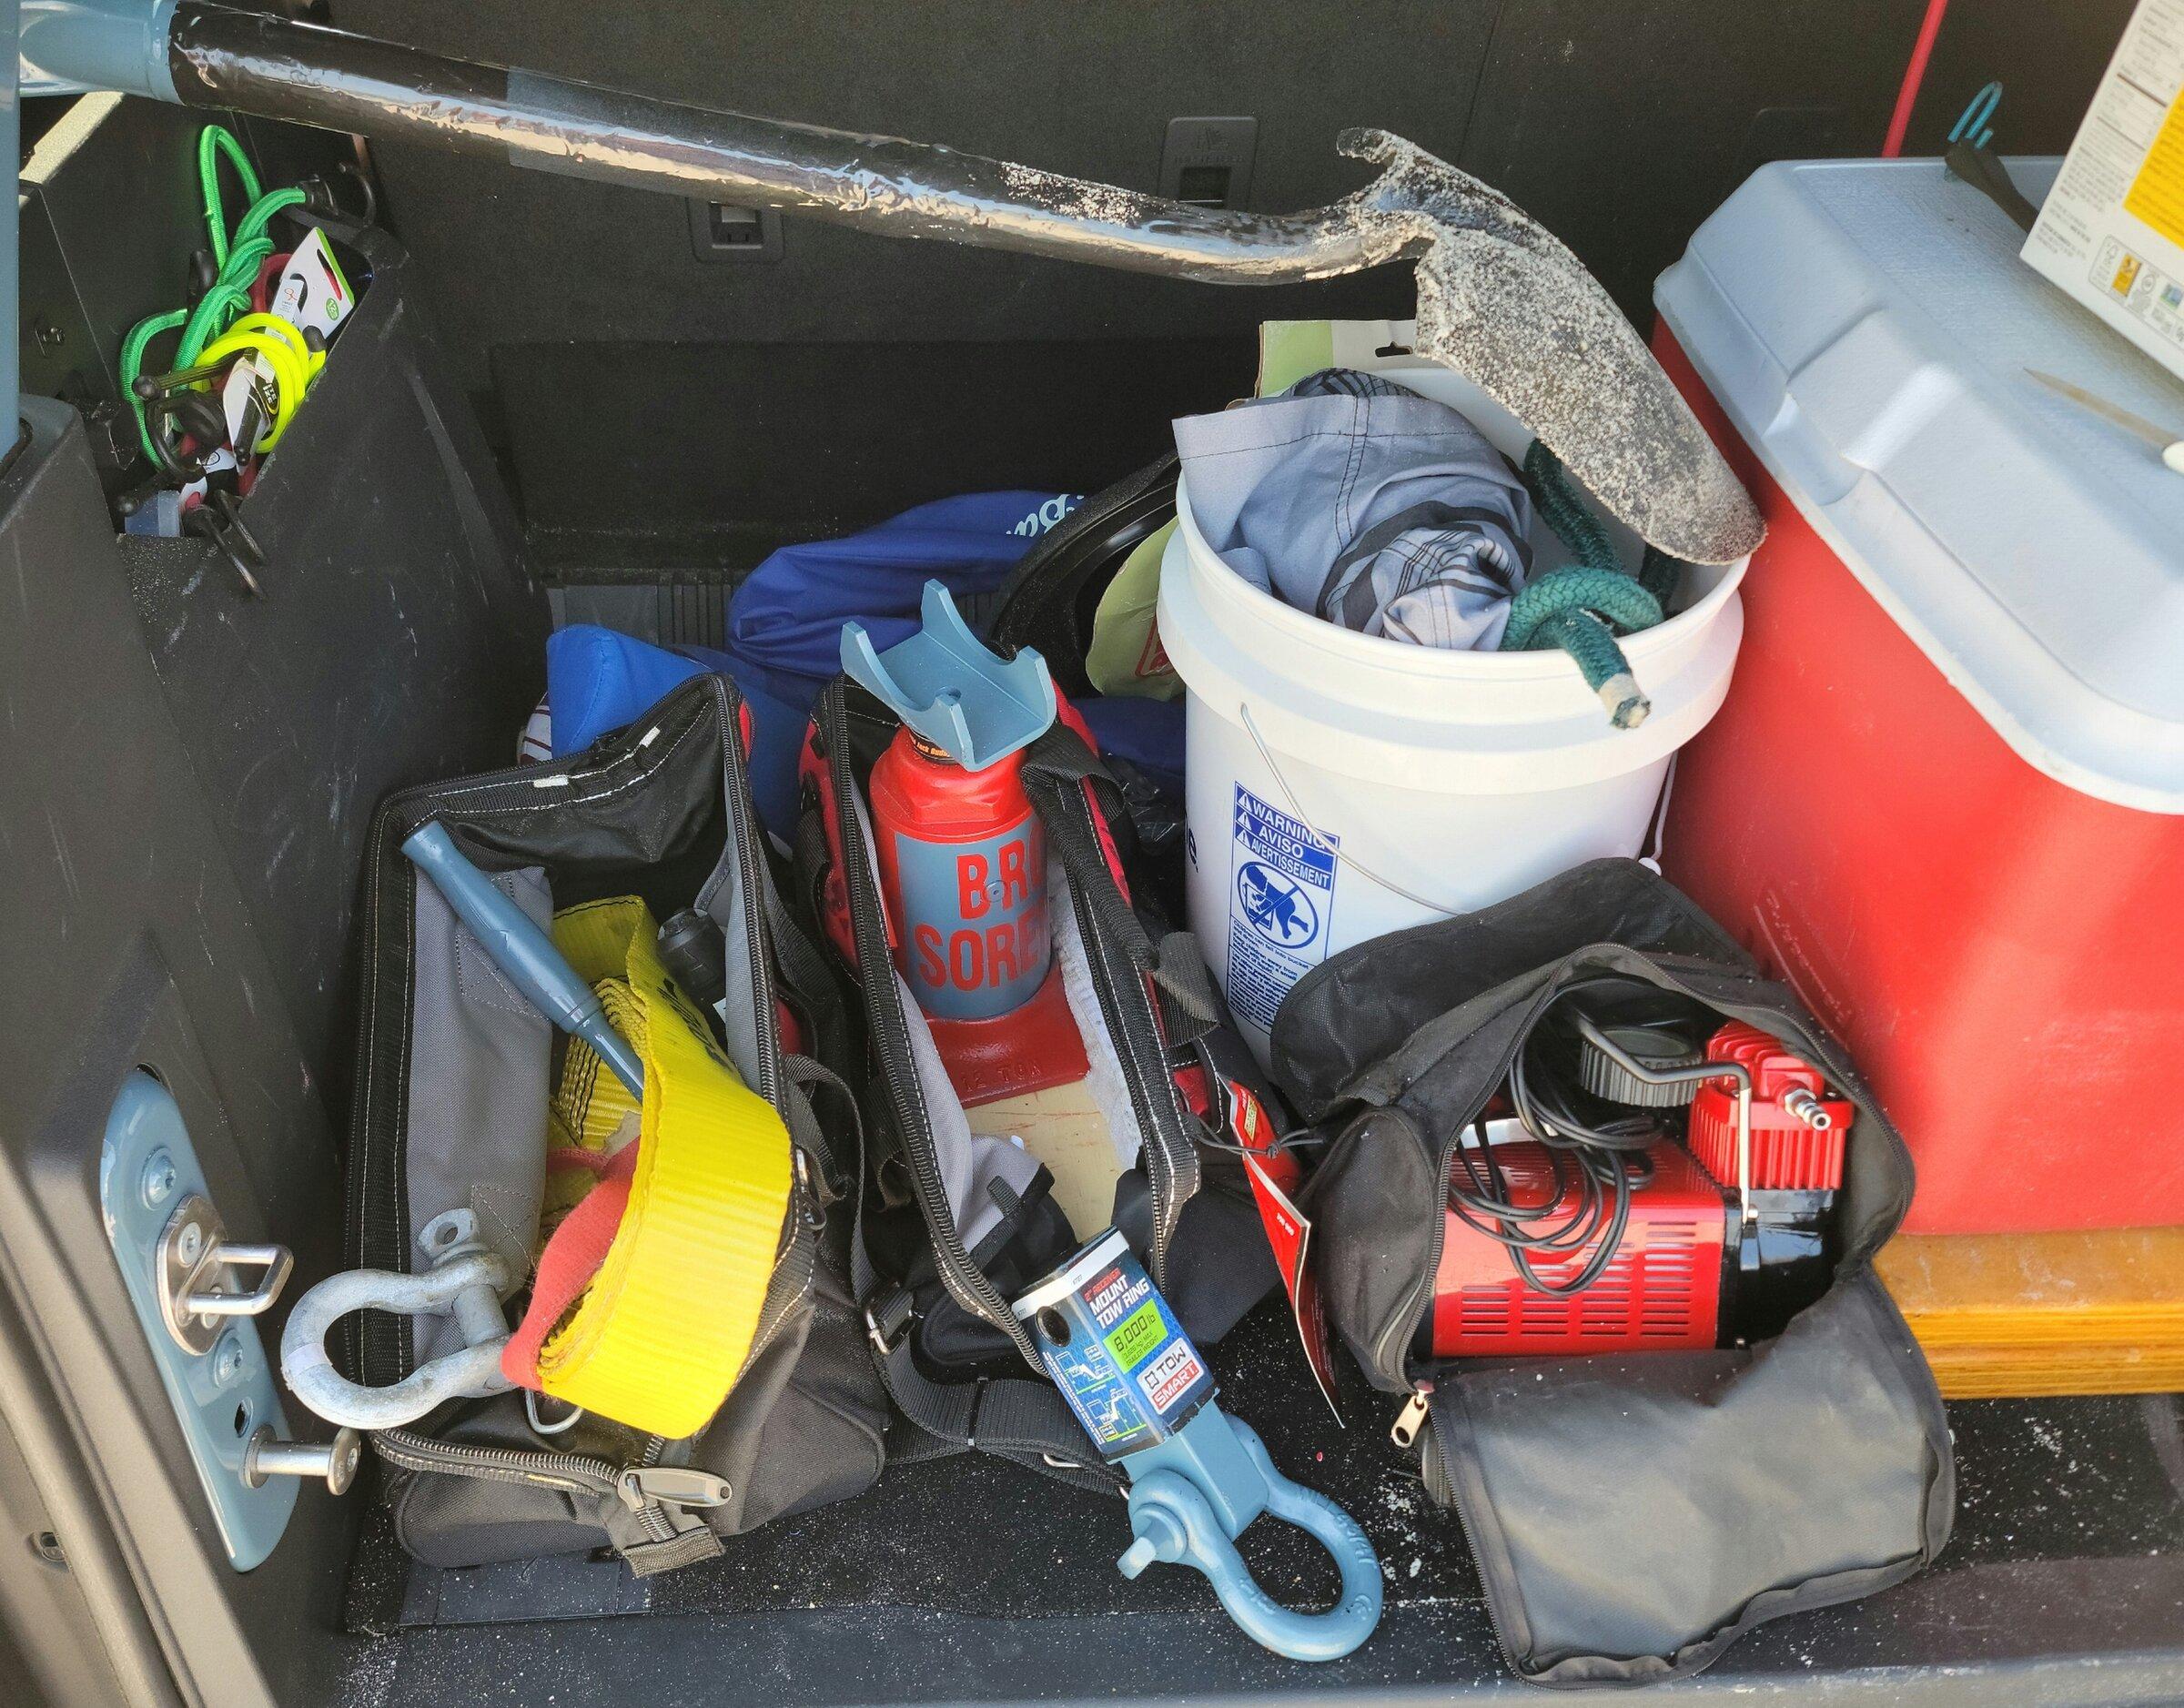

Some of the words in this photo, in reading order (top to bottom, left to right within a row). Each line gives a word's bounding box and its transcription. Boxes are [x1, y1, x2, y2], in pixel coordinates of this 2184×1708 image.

[1252, 800, 1326, 850] WARNING
[1259, 825, 1304, 858] AVISO
[1250, 838, 1330, 888] AVERTISSEMENT
[915, 897, 1046, 992] SORE
[1089, 1274, 1128, 1316] MOUNT
[1096, 1299, 1123, 1329] TOW
[1121, 1277, 1150, 1309] RING
[1114, 1315, 1148, 1352] 8,000
[1125, 1349, 1144, 1367] TRAILER
[1143, 1335, 1160, 1351] WEIGHT
[1156, 1347, 1187, 1375] TOW
